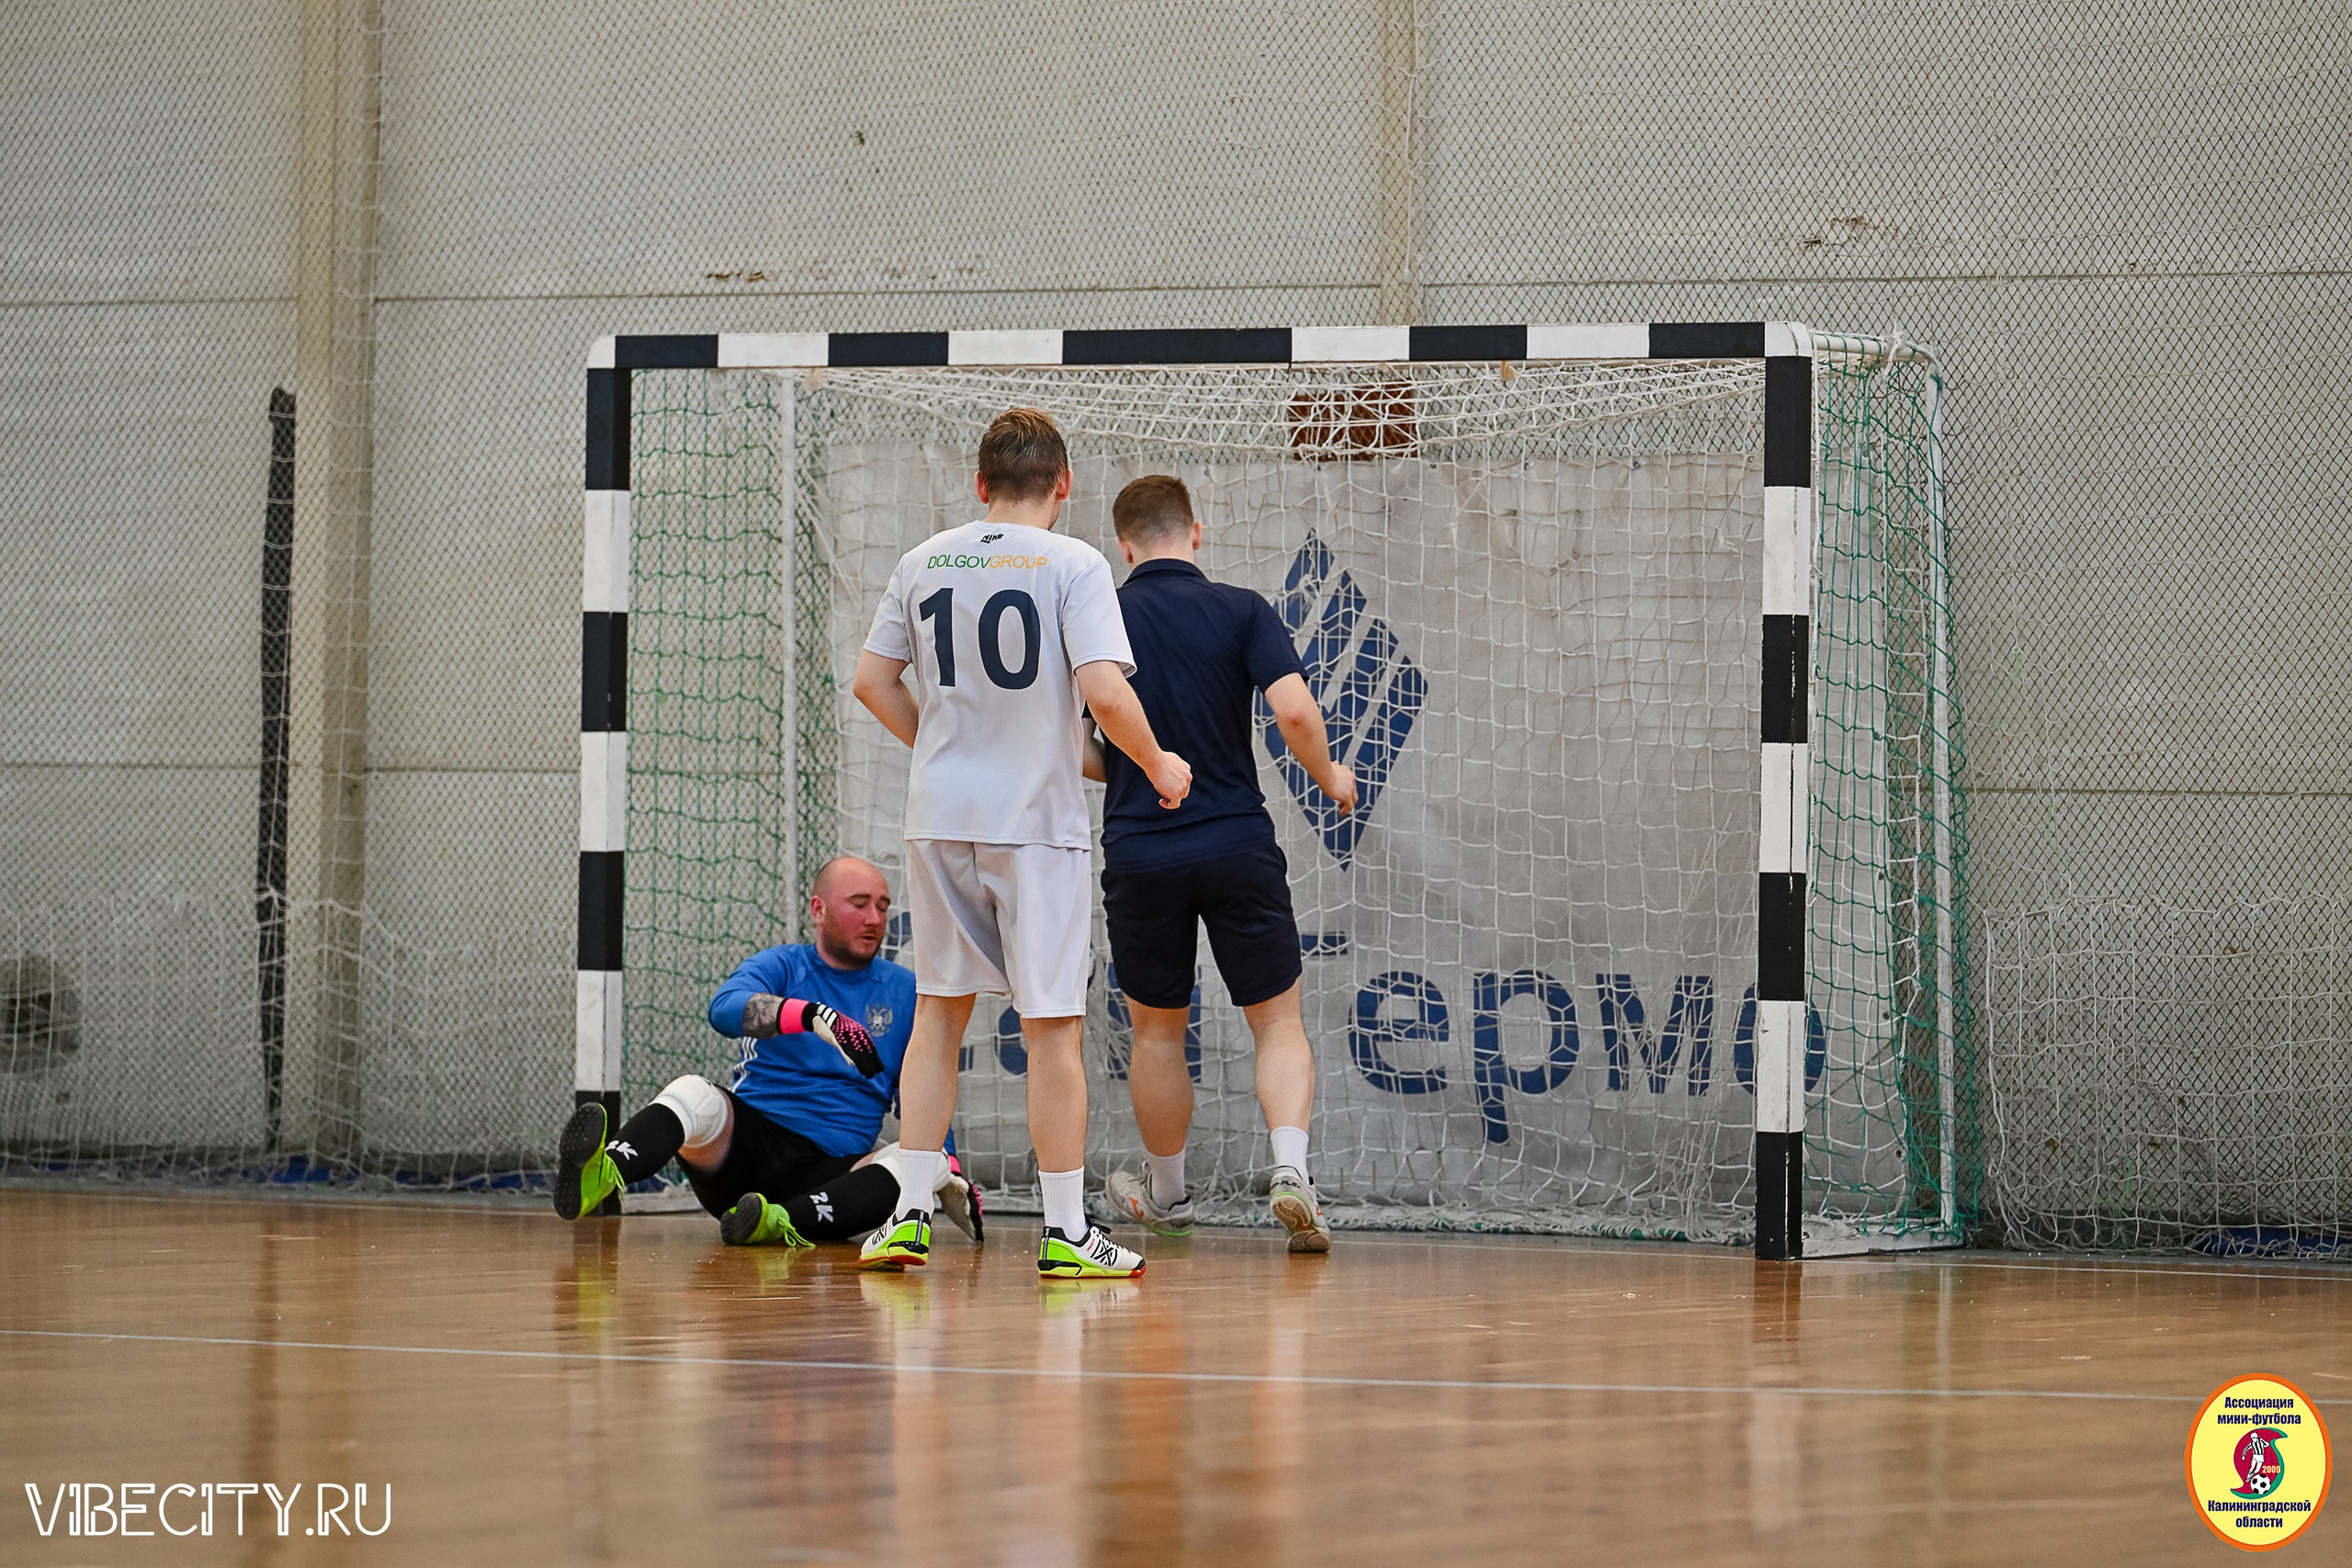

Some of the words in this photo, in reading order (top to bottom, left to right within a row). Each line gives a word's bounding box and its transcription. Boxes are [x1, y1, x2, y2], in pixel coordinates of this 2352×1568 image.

[927, 555, 1047, 570] DOLGOVGROUP
[919, 588, 1041, 690] 10
[1301, 930, 1825, 1145] ермо
